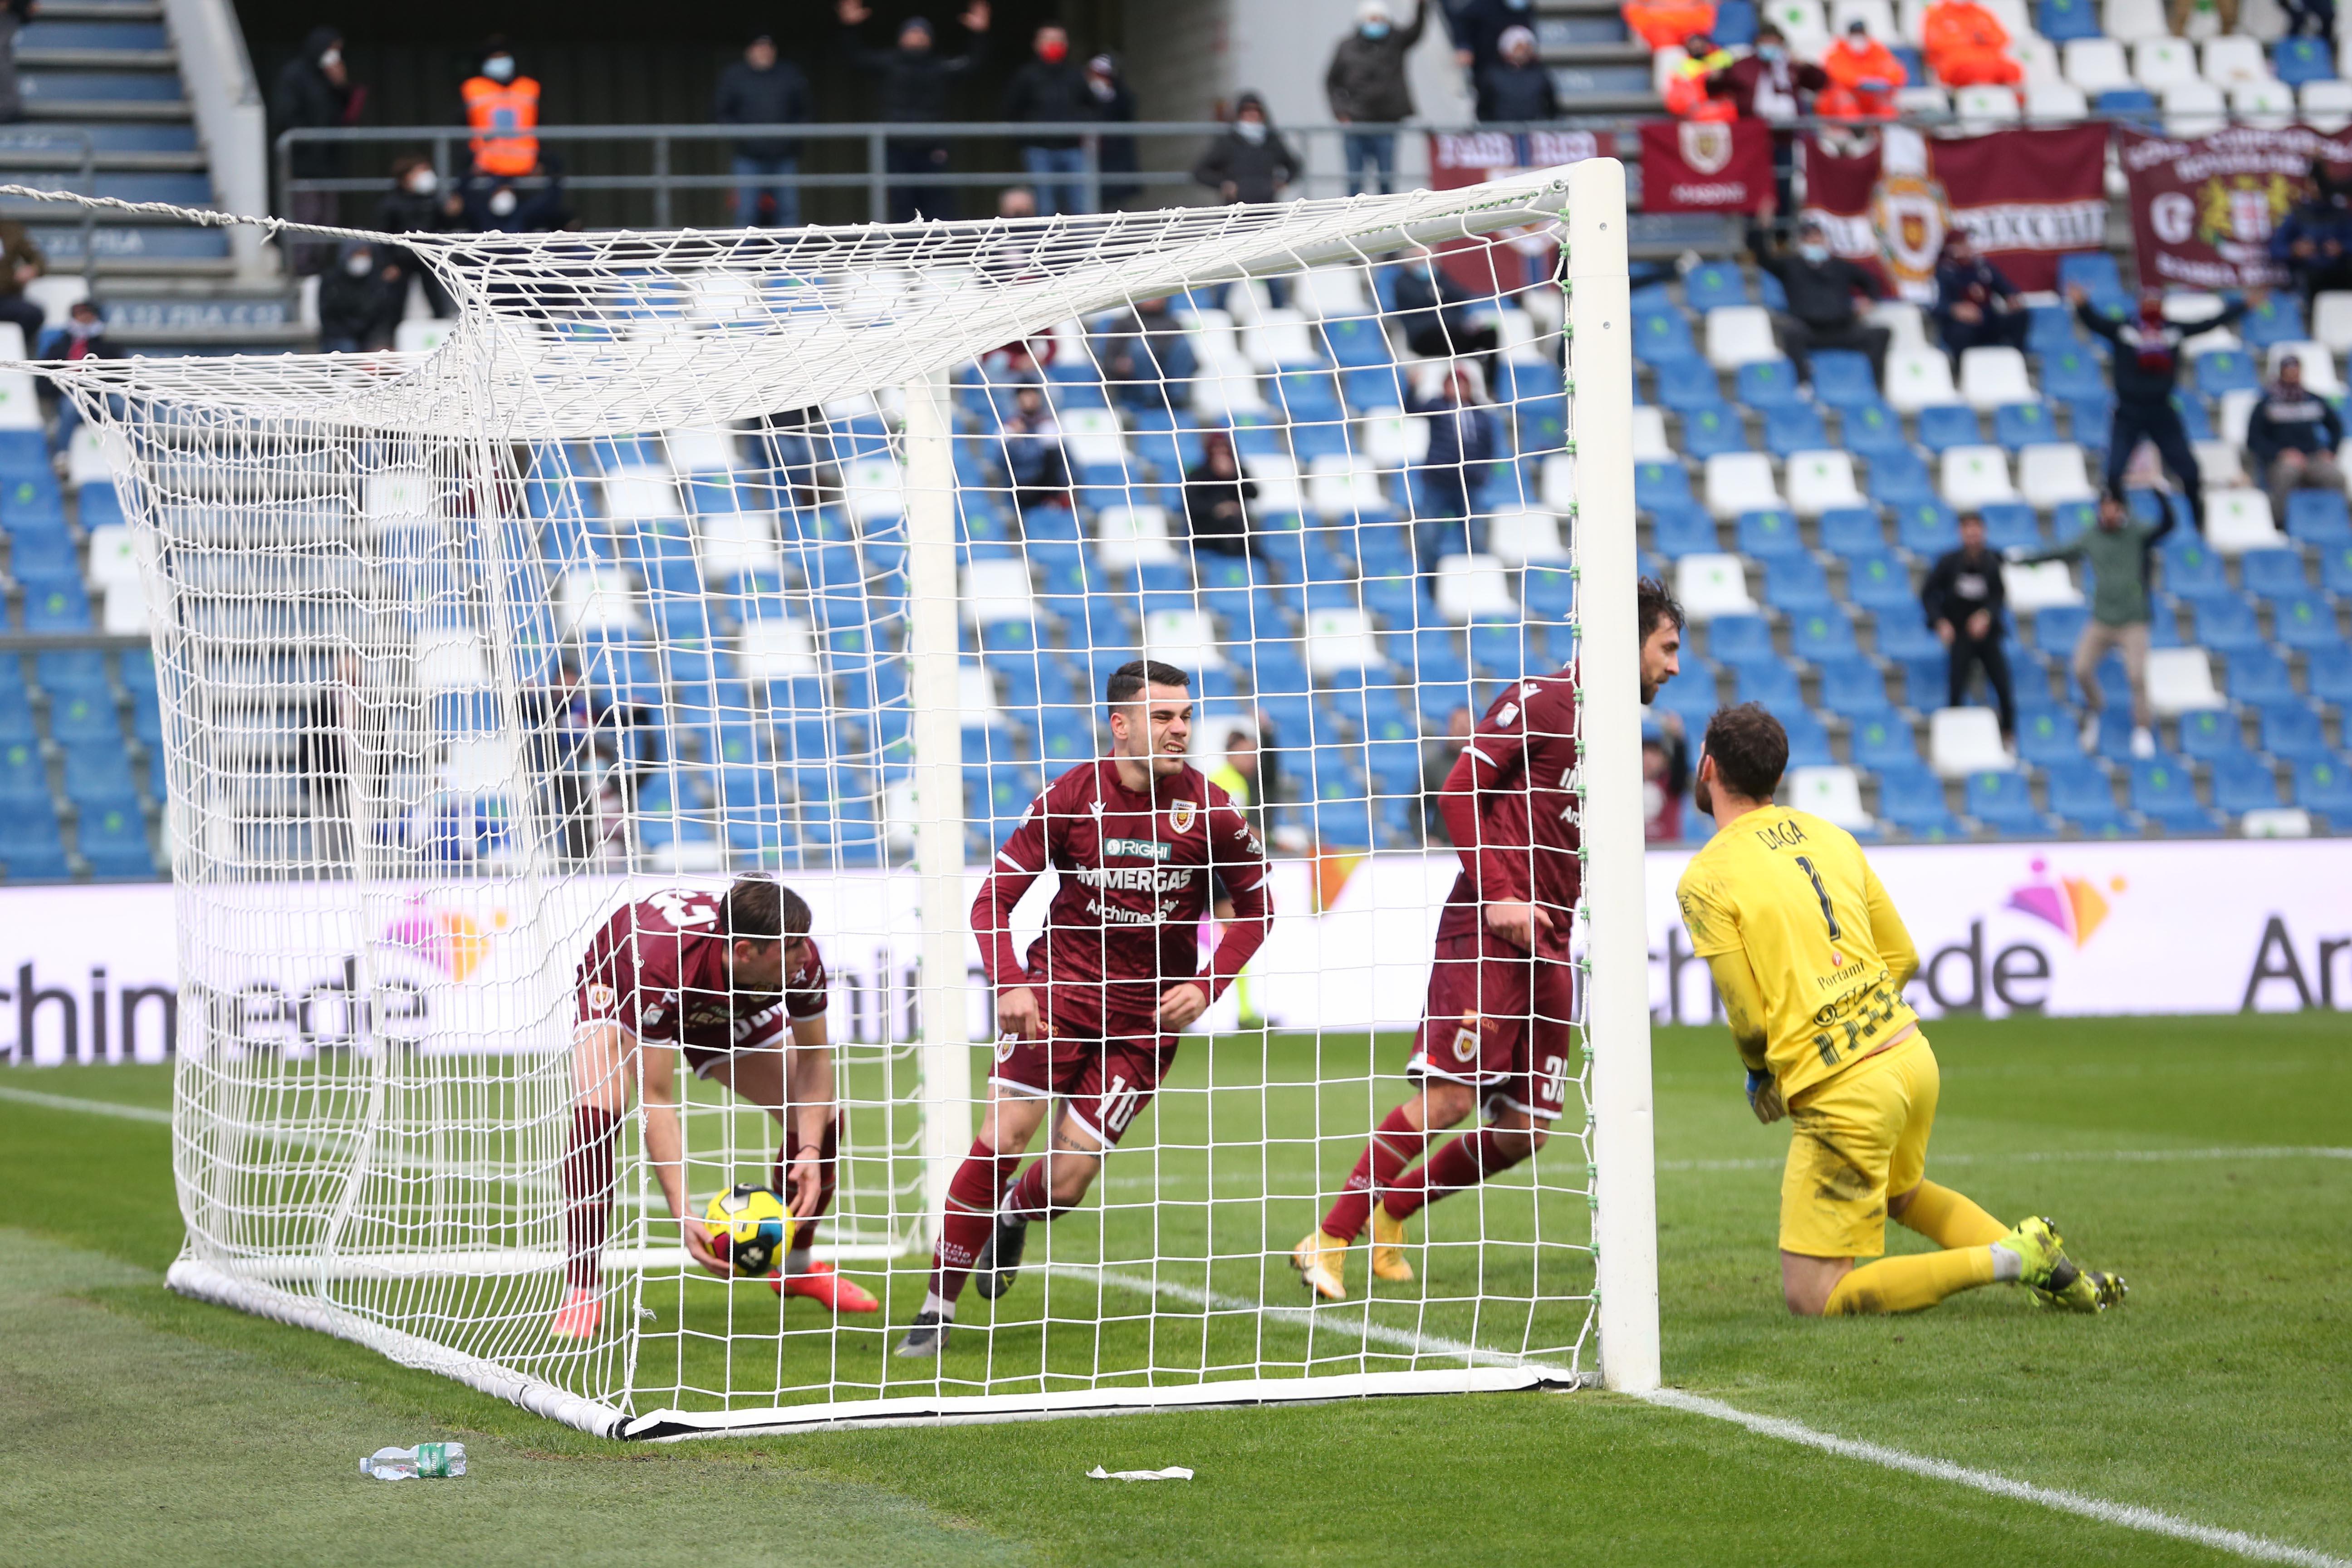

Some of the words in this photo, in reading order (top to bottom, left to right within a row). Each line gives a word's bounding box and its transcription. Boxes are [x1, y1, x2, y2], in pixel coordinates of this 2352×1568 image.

[1122, 840, 1168, 859] RIGHI
[1755, 819, 1808, 850] DAGA
[1075, 863, 1193, 892] IMMERGAS
[1795, 856, 1841, 942] 1
[1817, 957, 1866, 990] Portami
